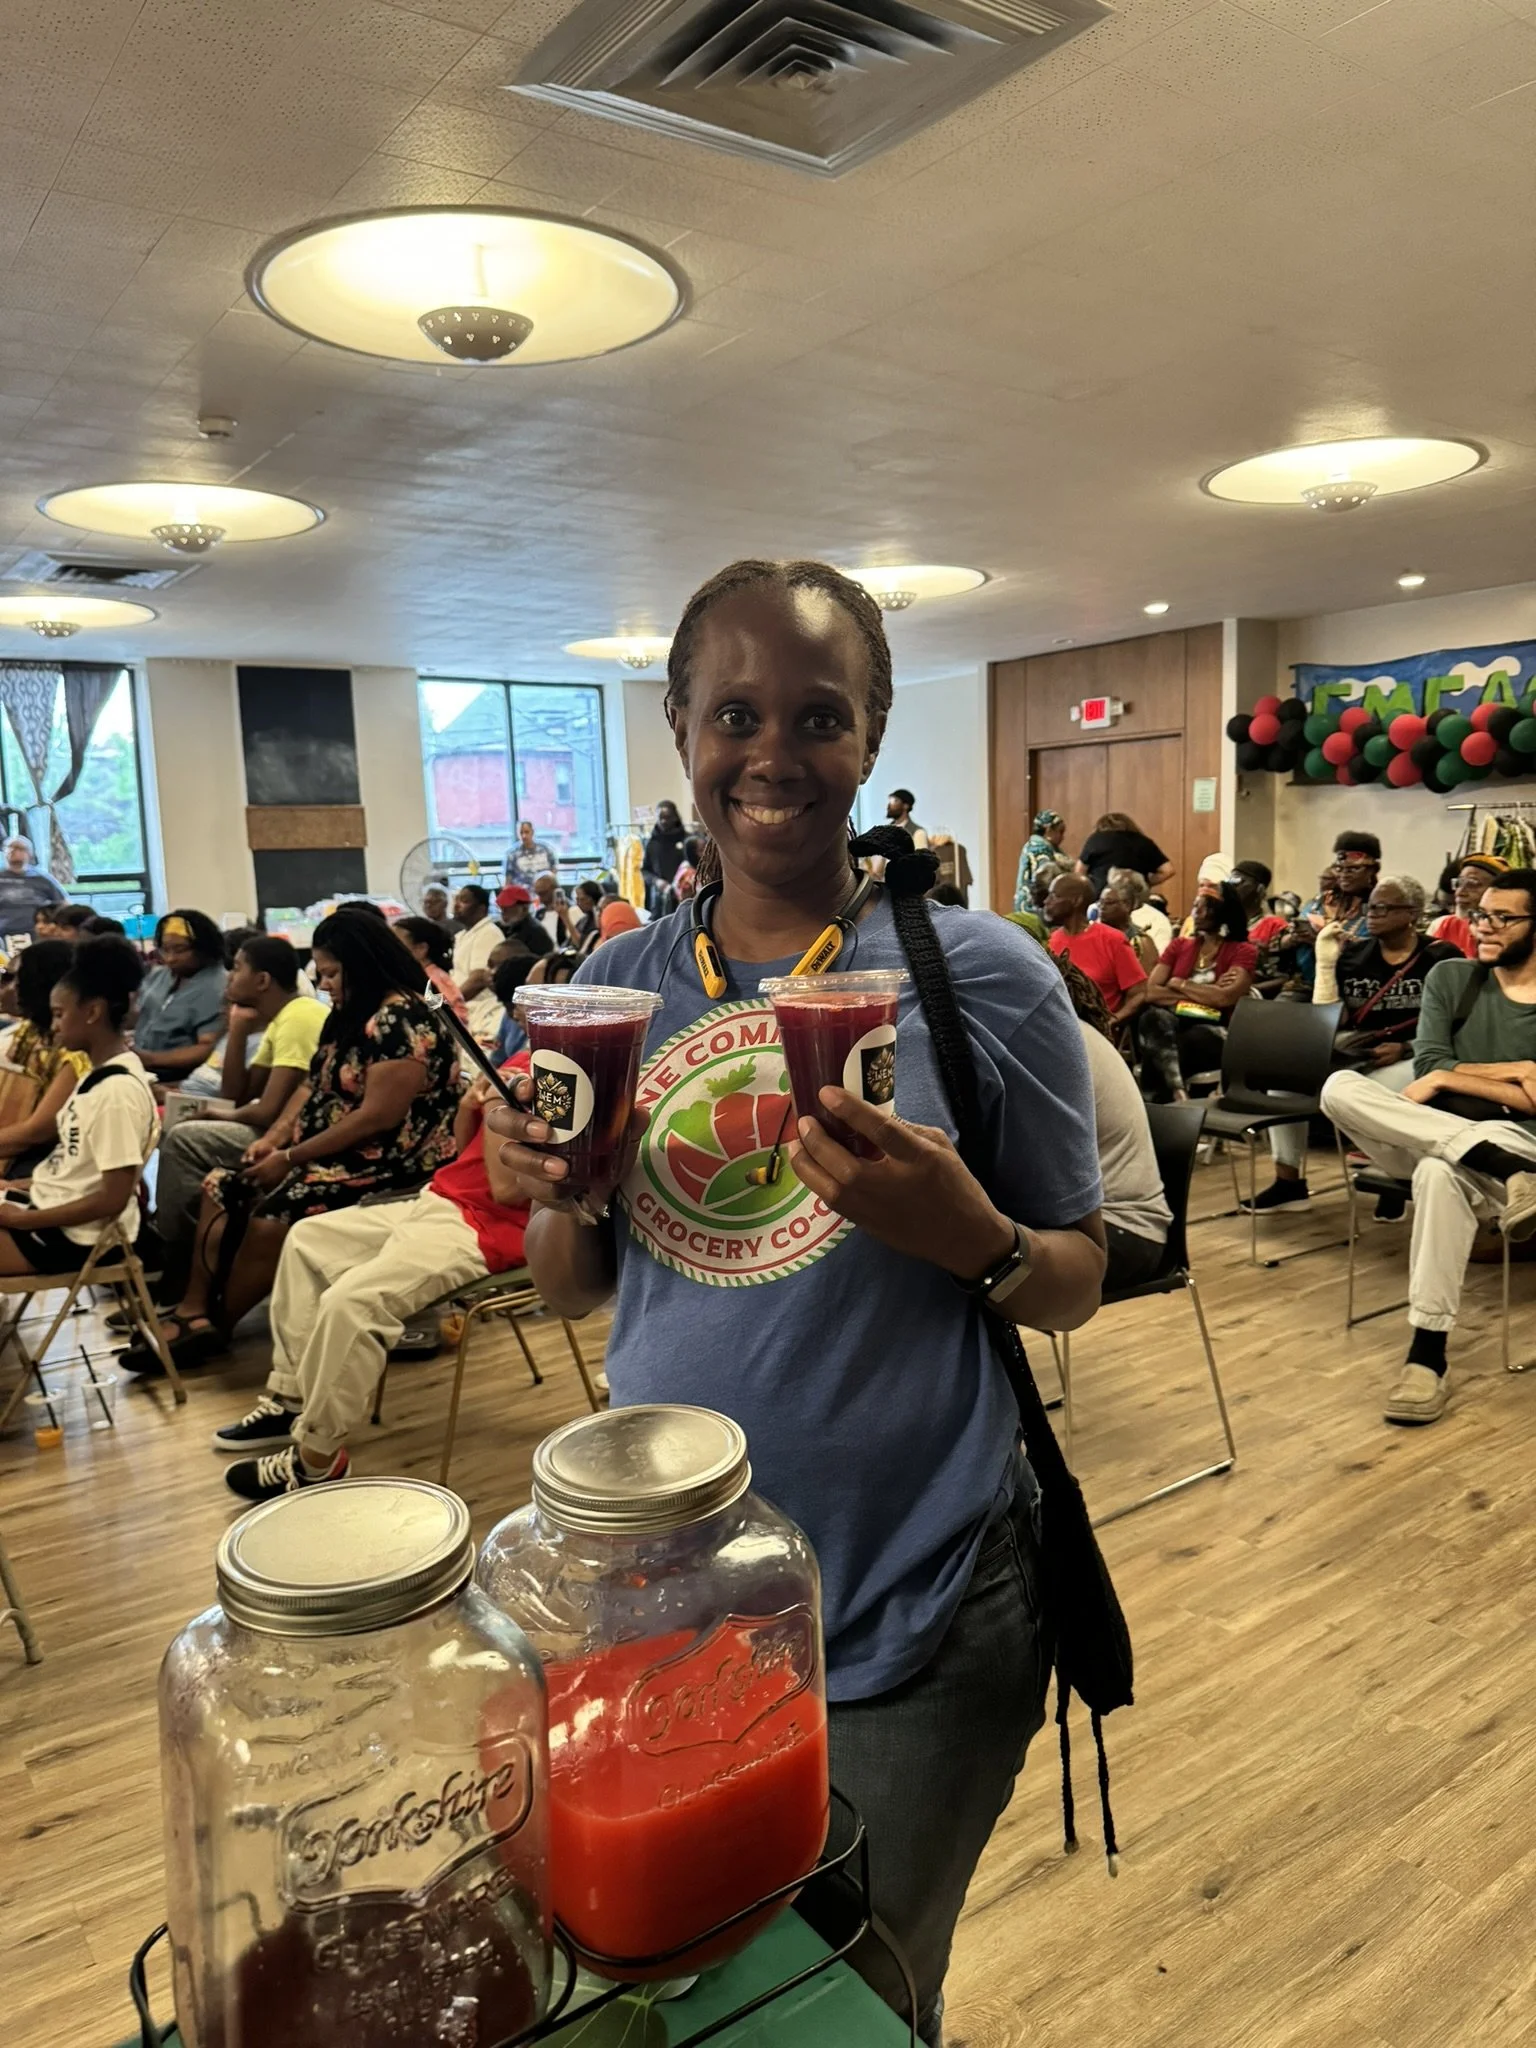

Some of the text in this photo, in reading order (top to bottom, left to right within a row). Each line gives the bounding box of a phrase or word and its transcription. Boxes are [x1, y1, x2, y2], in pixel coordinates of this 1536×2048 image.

[636, 1065, 681, 1110] NE
[636, 1192, 763, 1259] GROCERY
[299, 1762, 515, 1888] Yorkshire
